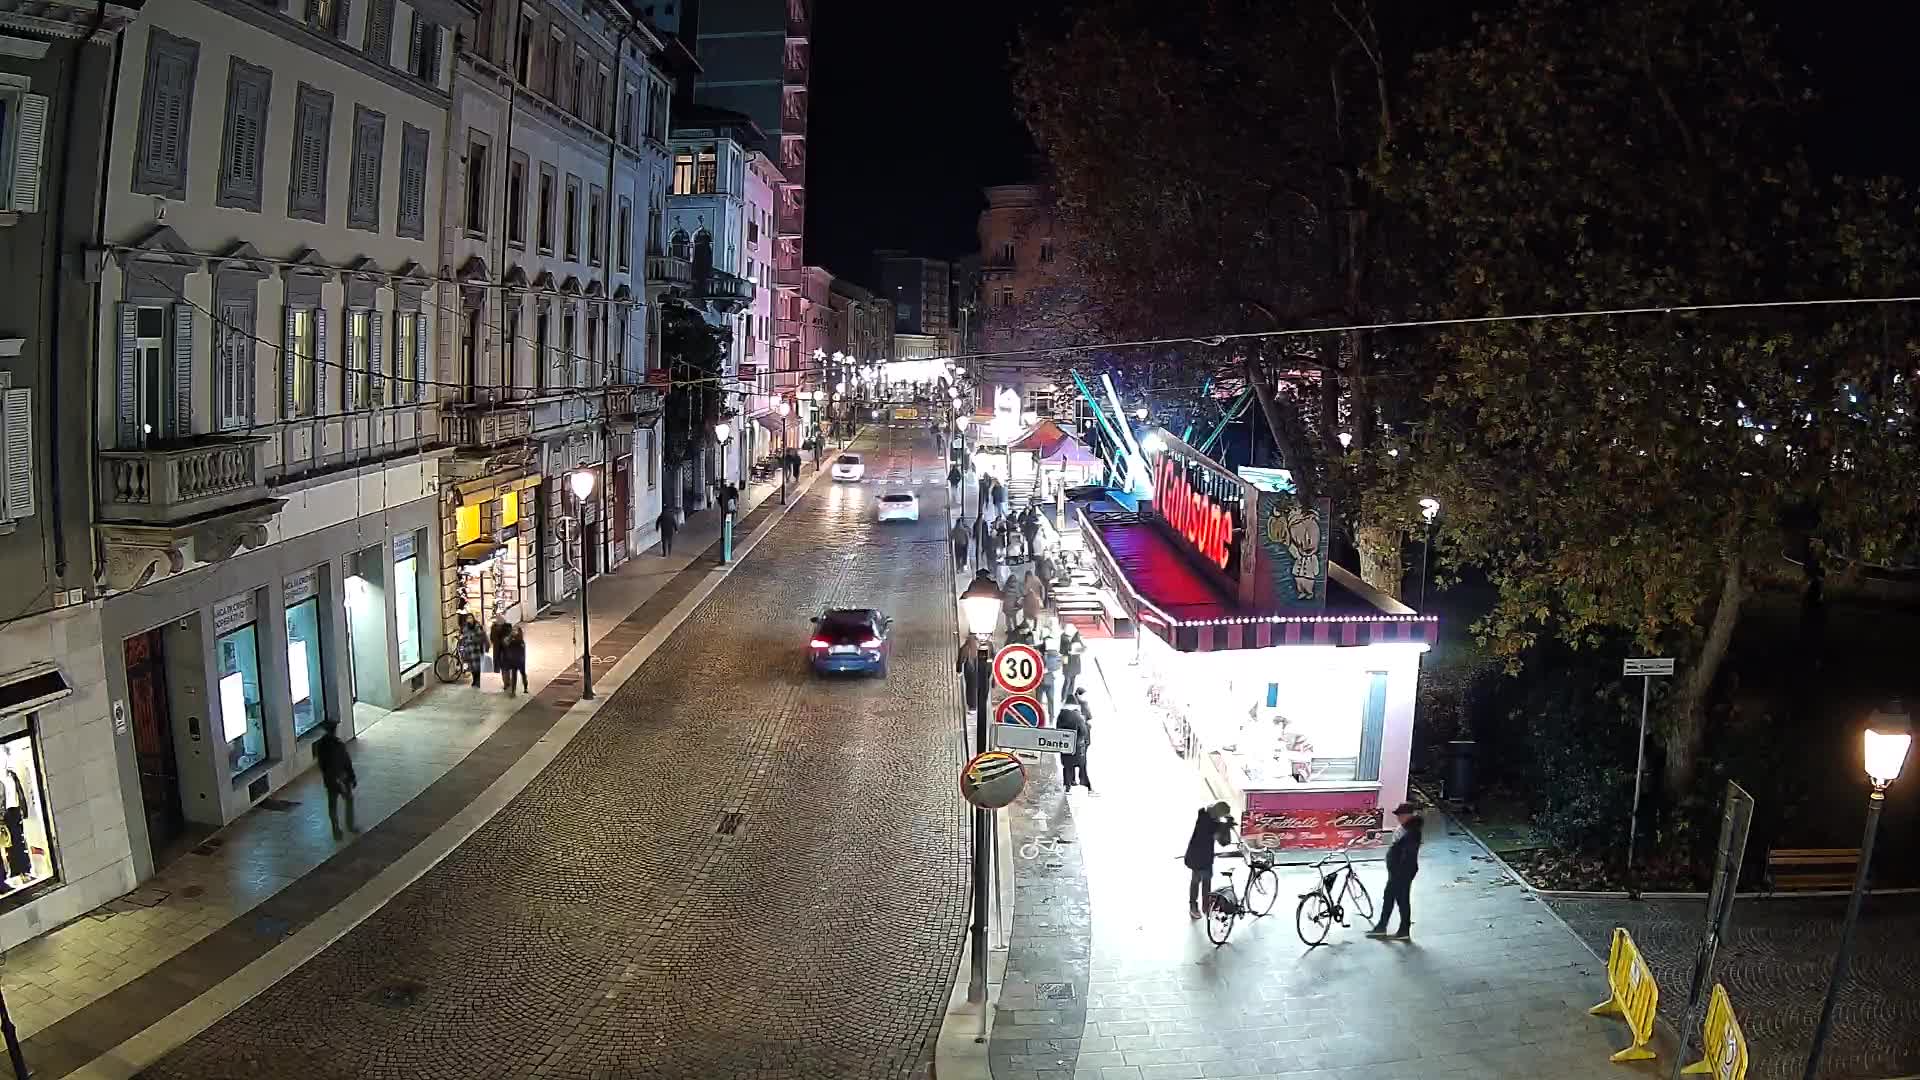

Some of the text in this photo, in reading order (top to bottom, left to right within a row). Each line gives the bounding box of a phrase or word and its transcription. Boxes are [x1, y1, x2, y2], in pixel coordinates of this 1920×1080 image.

[1162, 459, 1233, 569] Golosone
[1005, 657, 1033, 680] 30
[1038, 738, 1069, 749] Dante
